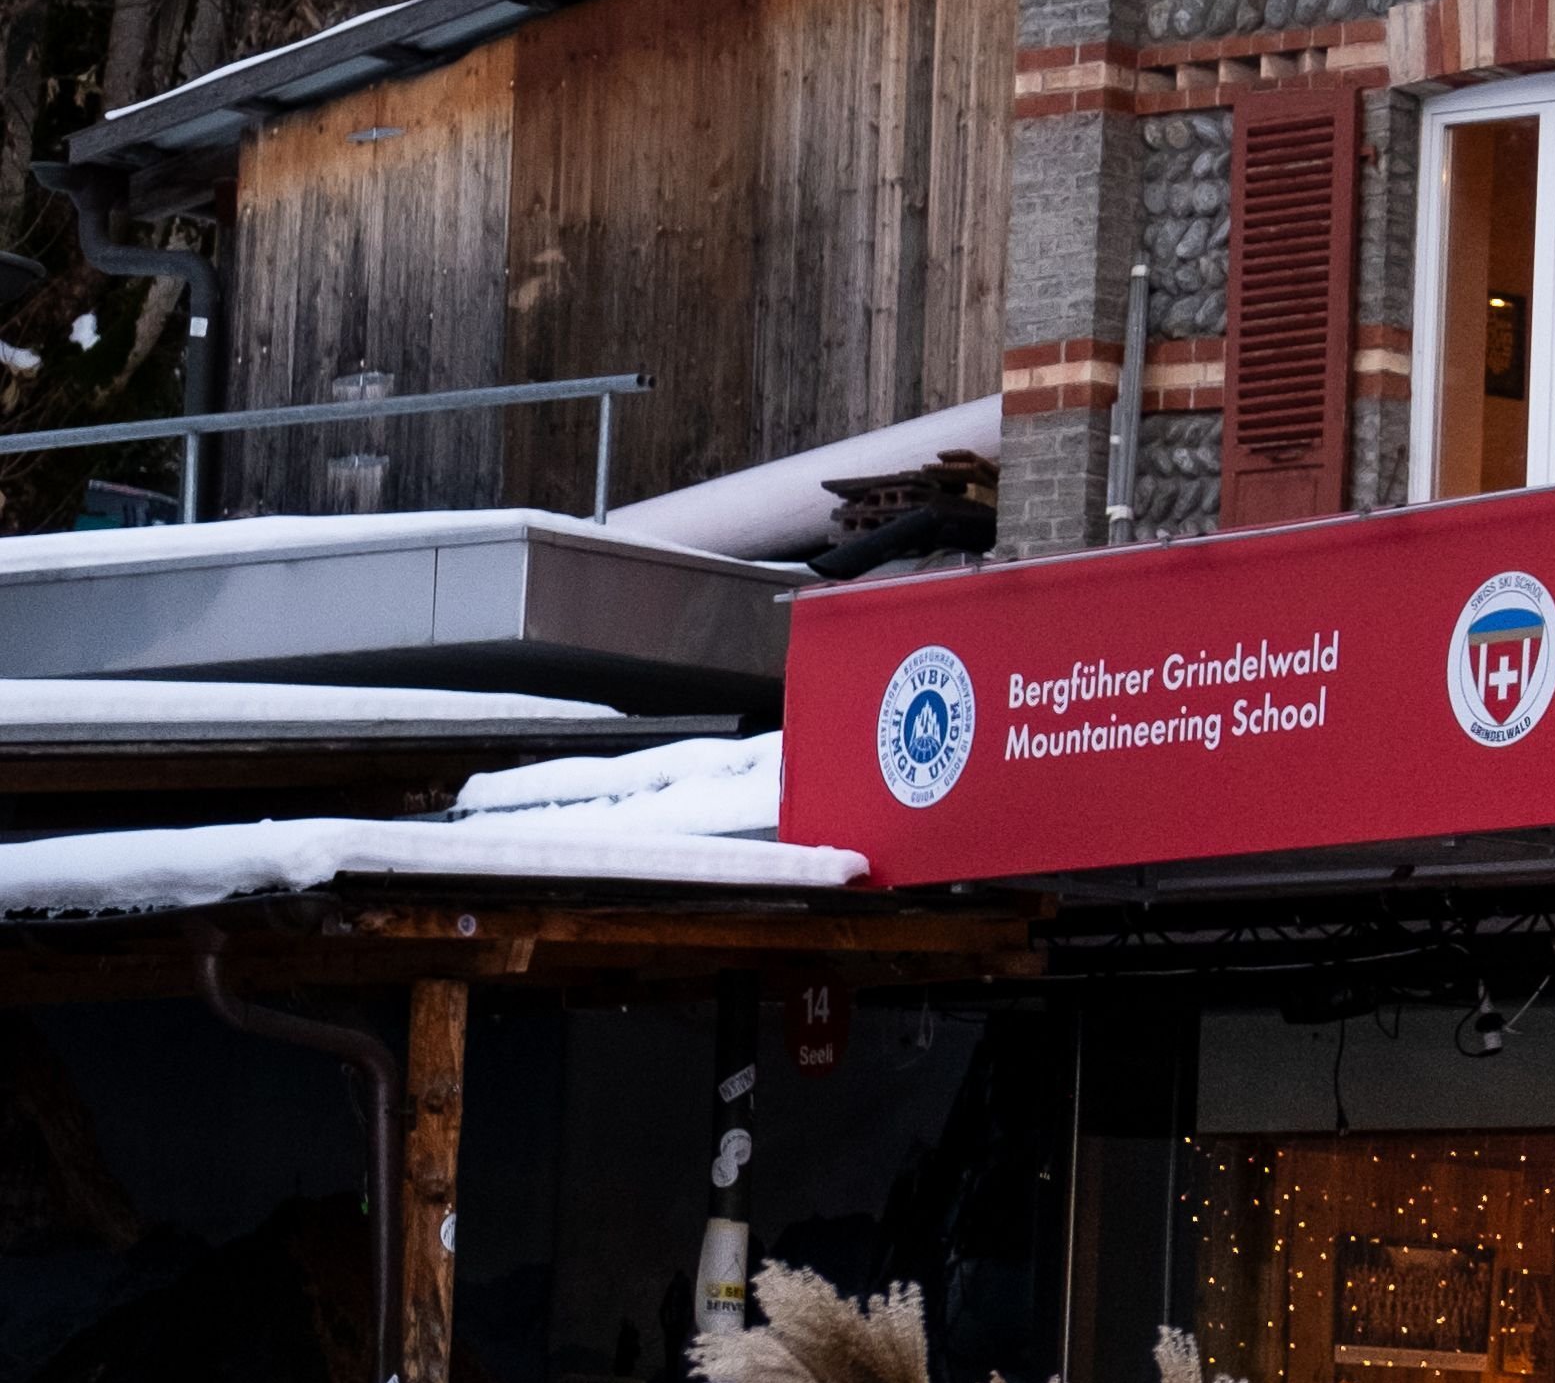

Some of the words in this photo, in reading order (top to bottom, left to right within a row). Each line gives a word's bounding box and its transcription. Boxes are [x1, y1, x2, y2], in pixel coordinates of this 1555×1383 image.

[1471, 582, 1496, 611] SWISS
[1499, 576, 1512, 590] SKI
[911, 669, 950, 692] IVBV
[1009, 659, 1155, 714] Bergführer
[1162, 630, 1340, 692] Grindelwald
[1004, 706, 1222, 761] Mountaineering
[1231, 685, 1327, 737] School
[1470, 717, 1531, 742] GRINDELWALD
[802, 986, 830, 1025] 14
[800, 1042, 834, 1066] Seeli
